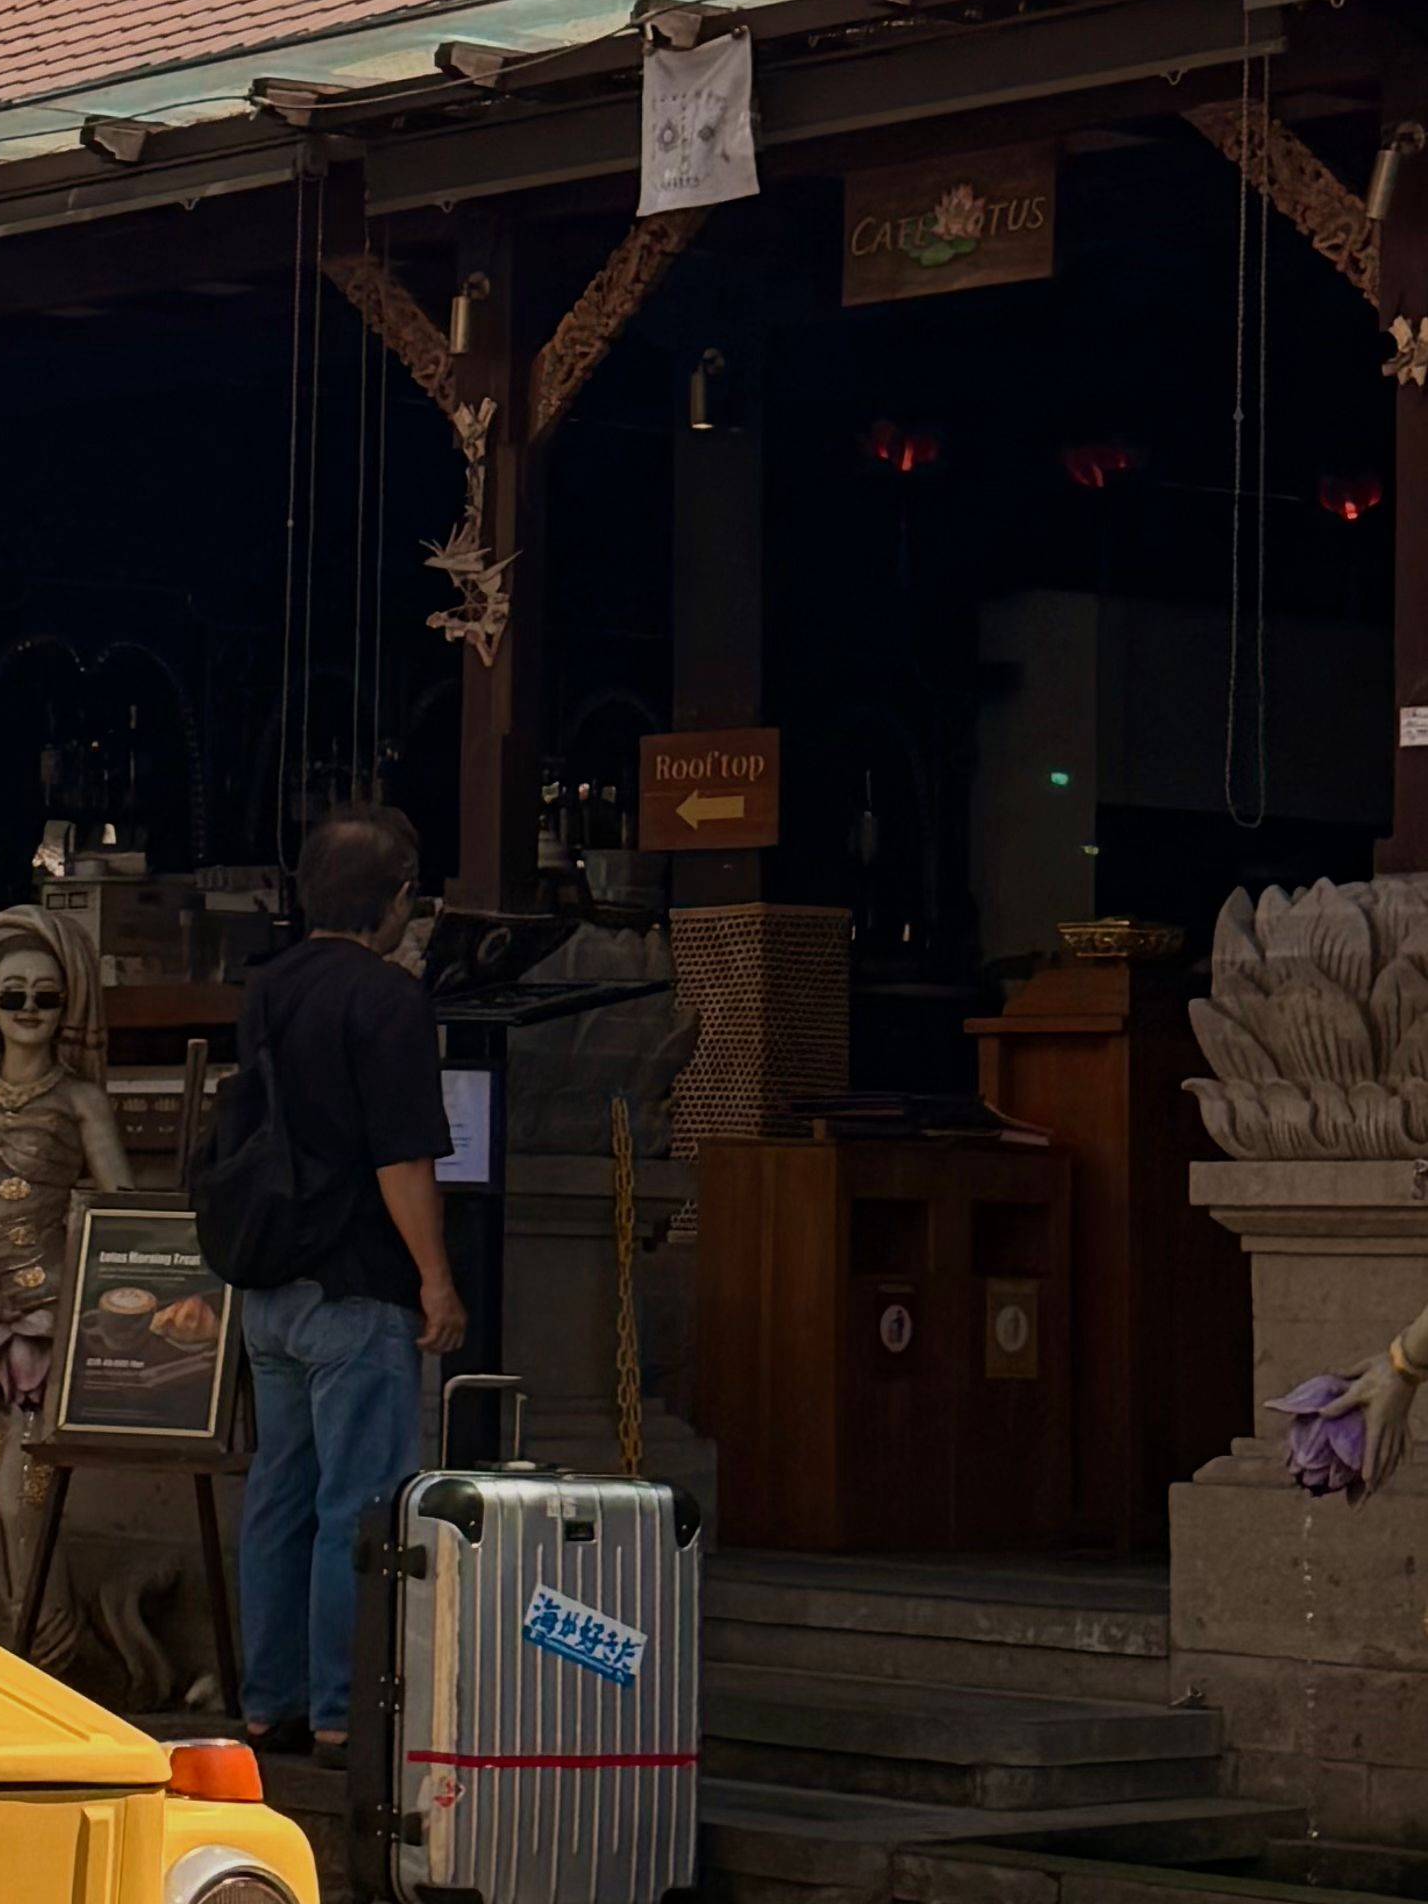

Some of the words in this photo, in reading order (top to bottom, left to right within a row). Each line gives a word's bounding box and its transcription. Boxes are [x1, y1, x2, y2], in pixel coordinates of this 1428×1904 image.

[655, 750, 765, 783] Rooftop
[531, 1592, 643, 1671] 海が好きだ
